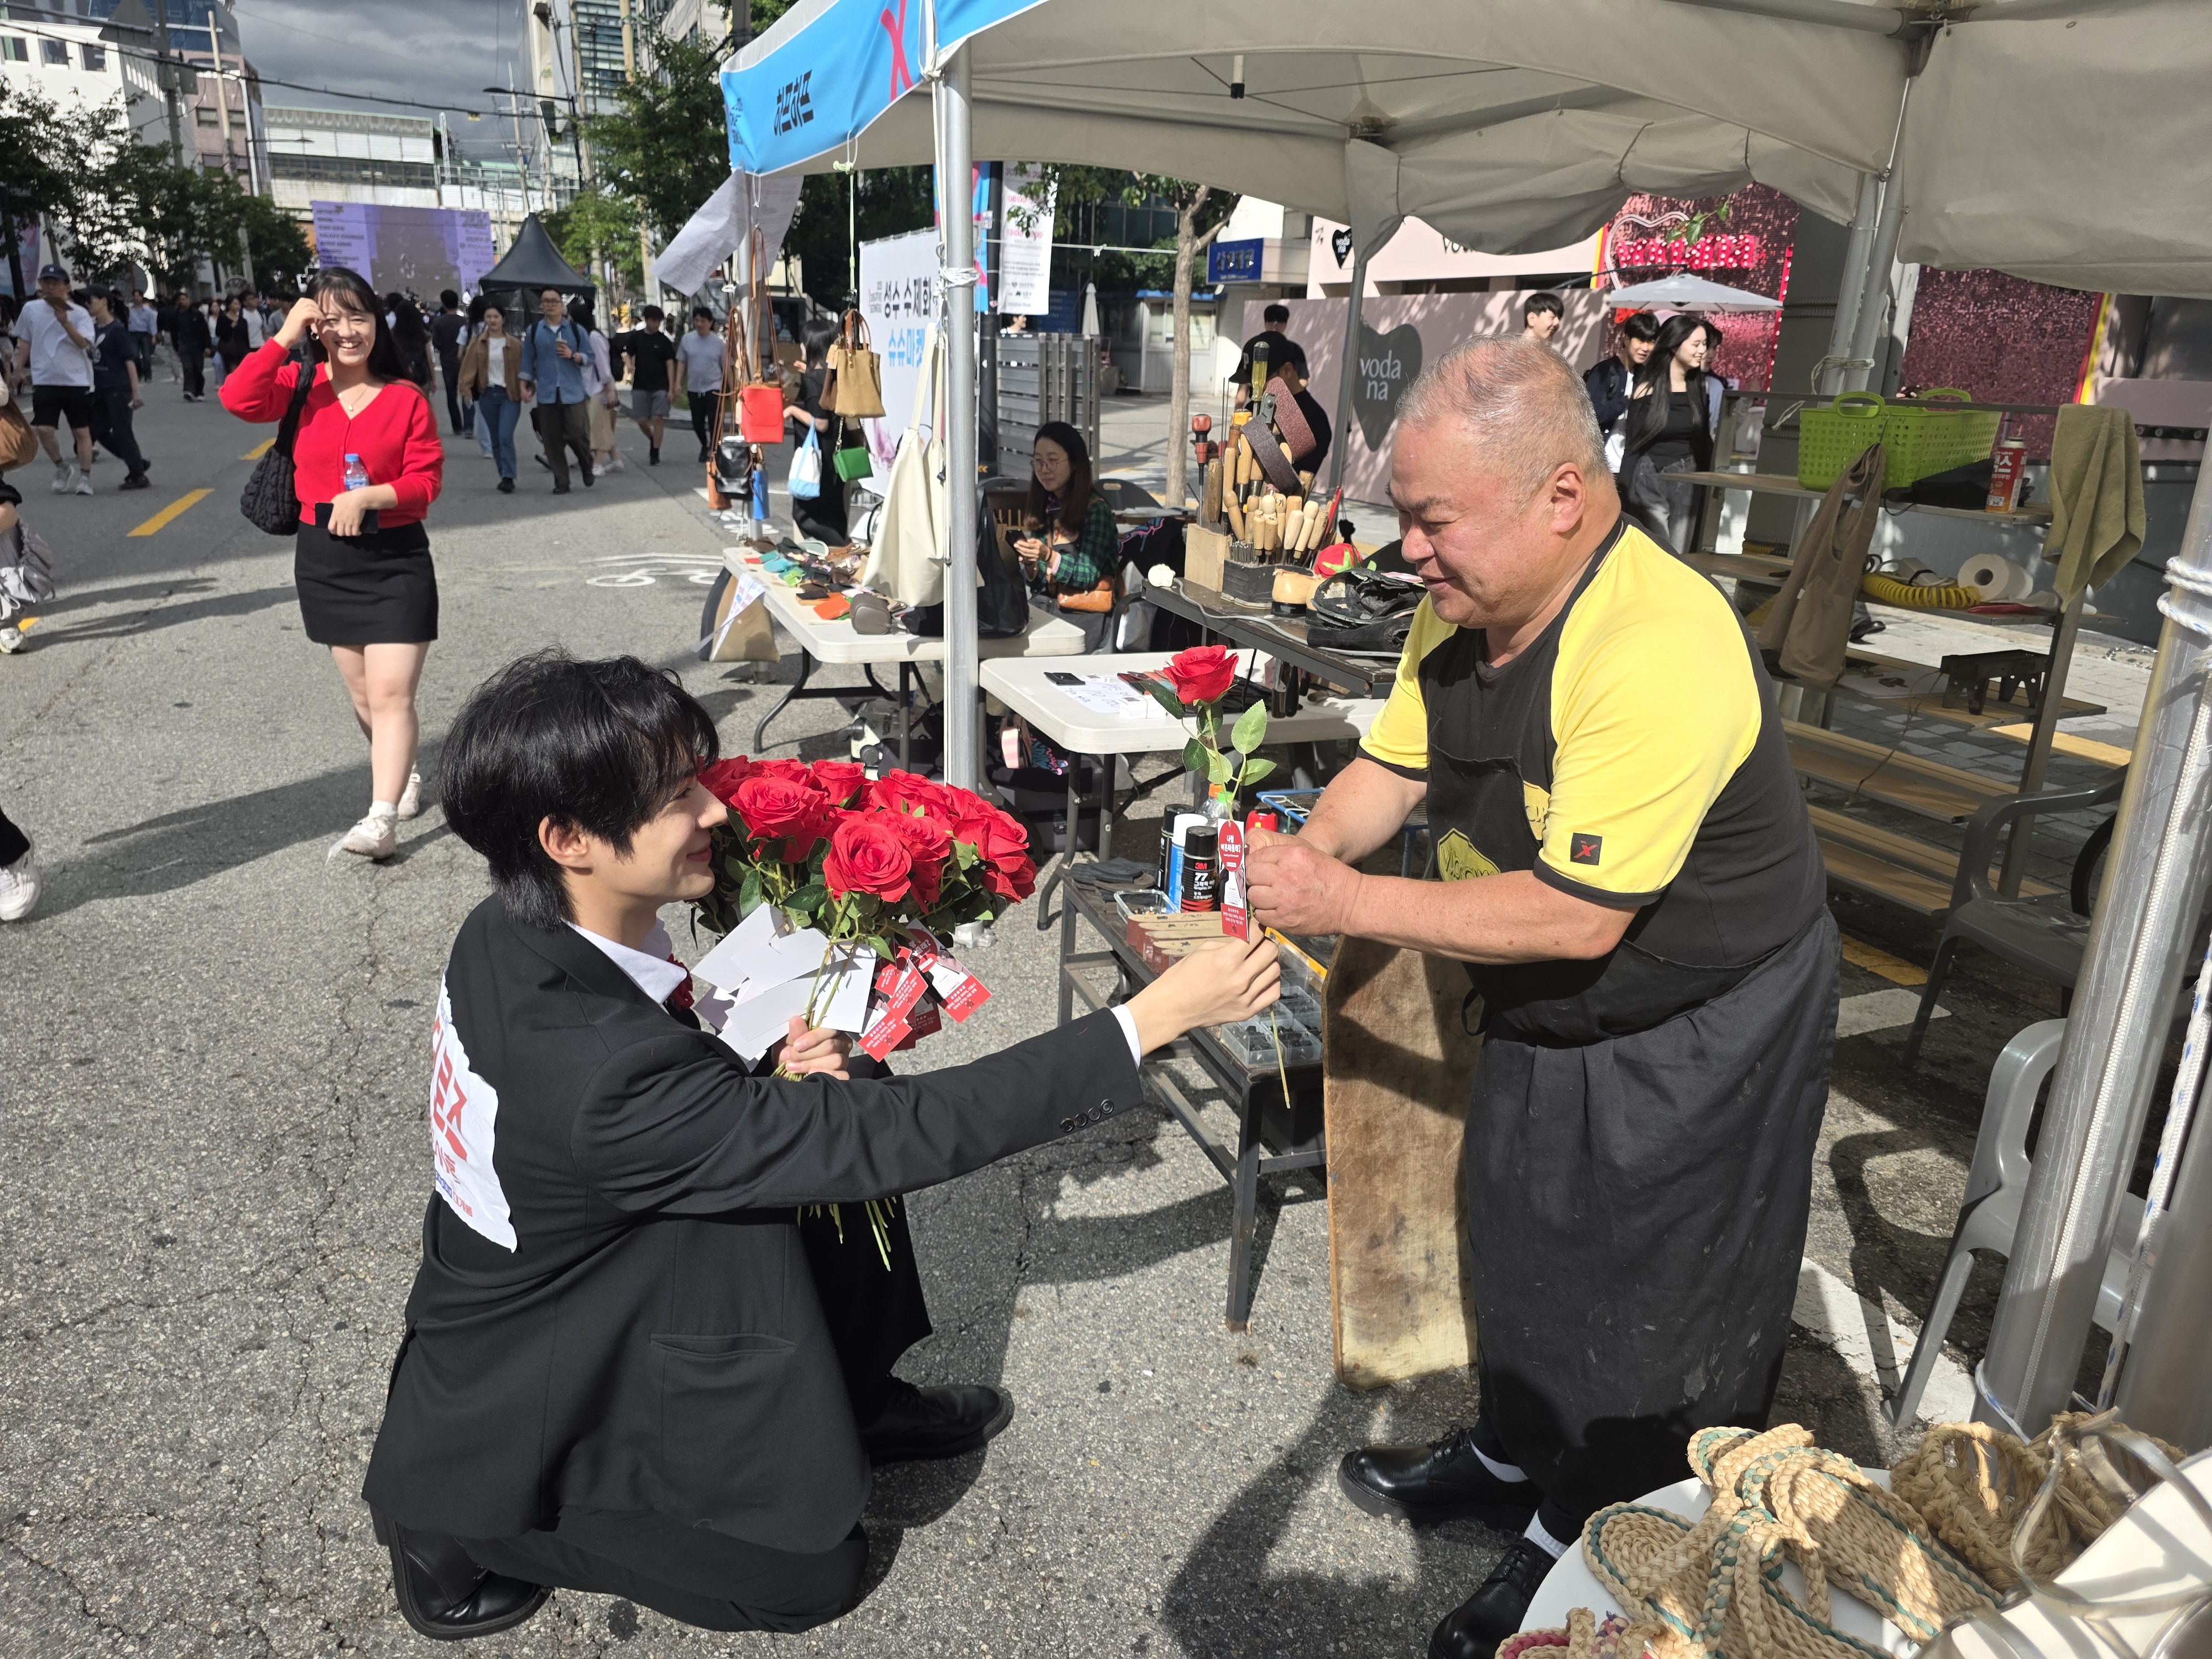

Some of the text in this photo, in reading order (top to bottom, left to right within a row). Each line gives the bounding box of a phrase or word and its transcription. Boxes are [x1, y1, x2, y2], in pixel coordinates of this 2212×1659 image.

[884, 276, 931, 320] 성수 수제화
[1360, 349, 1401, 379] voda
[1366, 380, 1389, 400] na
[1194, 872, 1208, 881] 77
